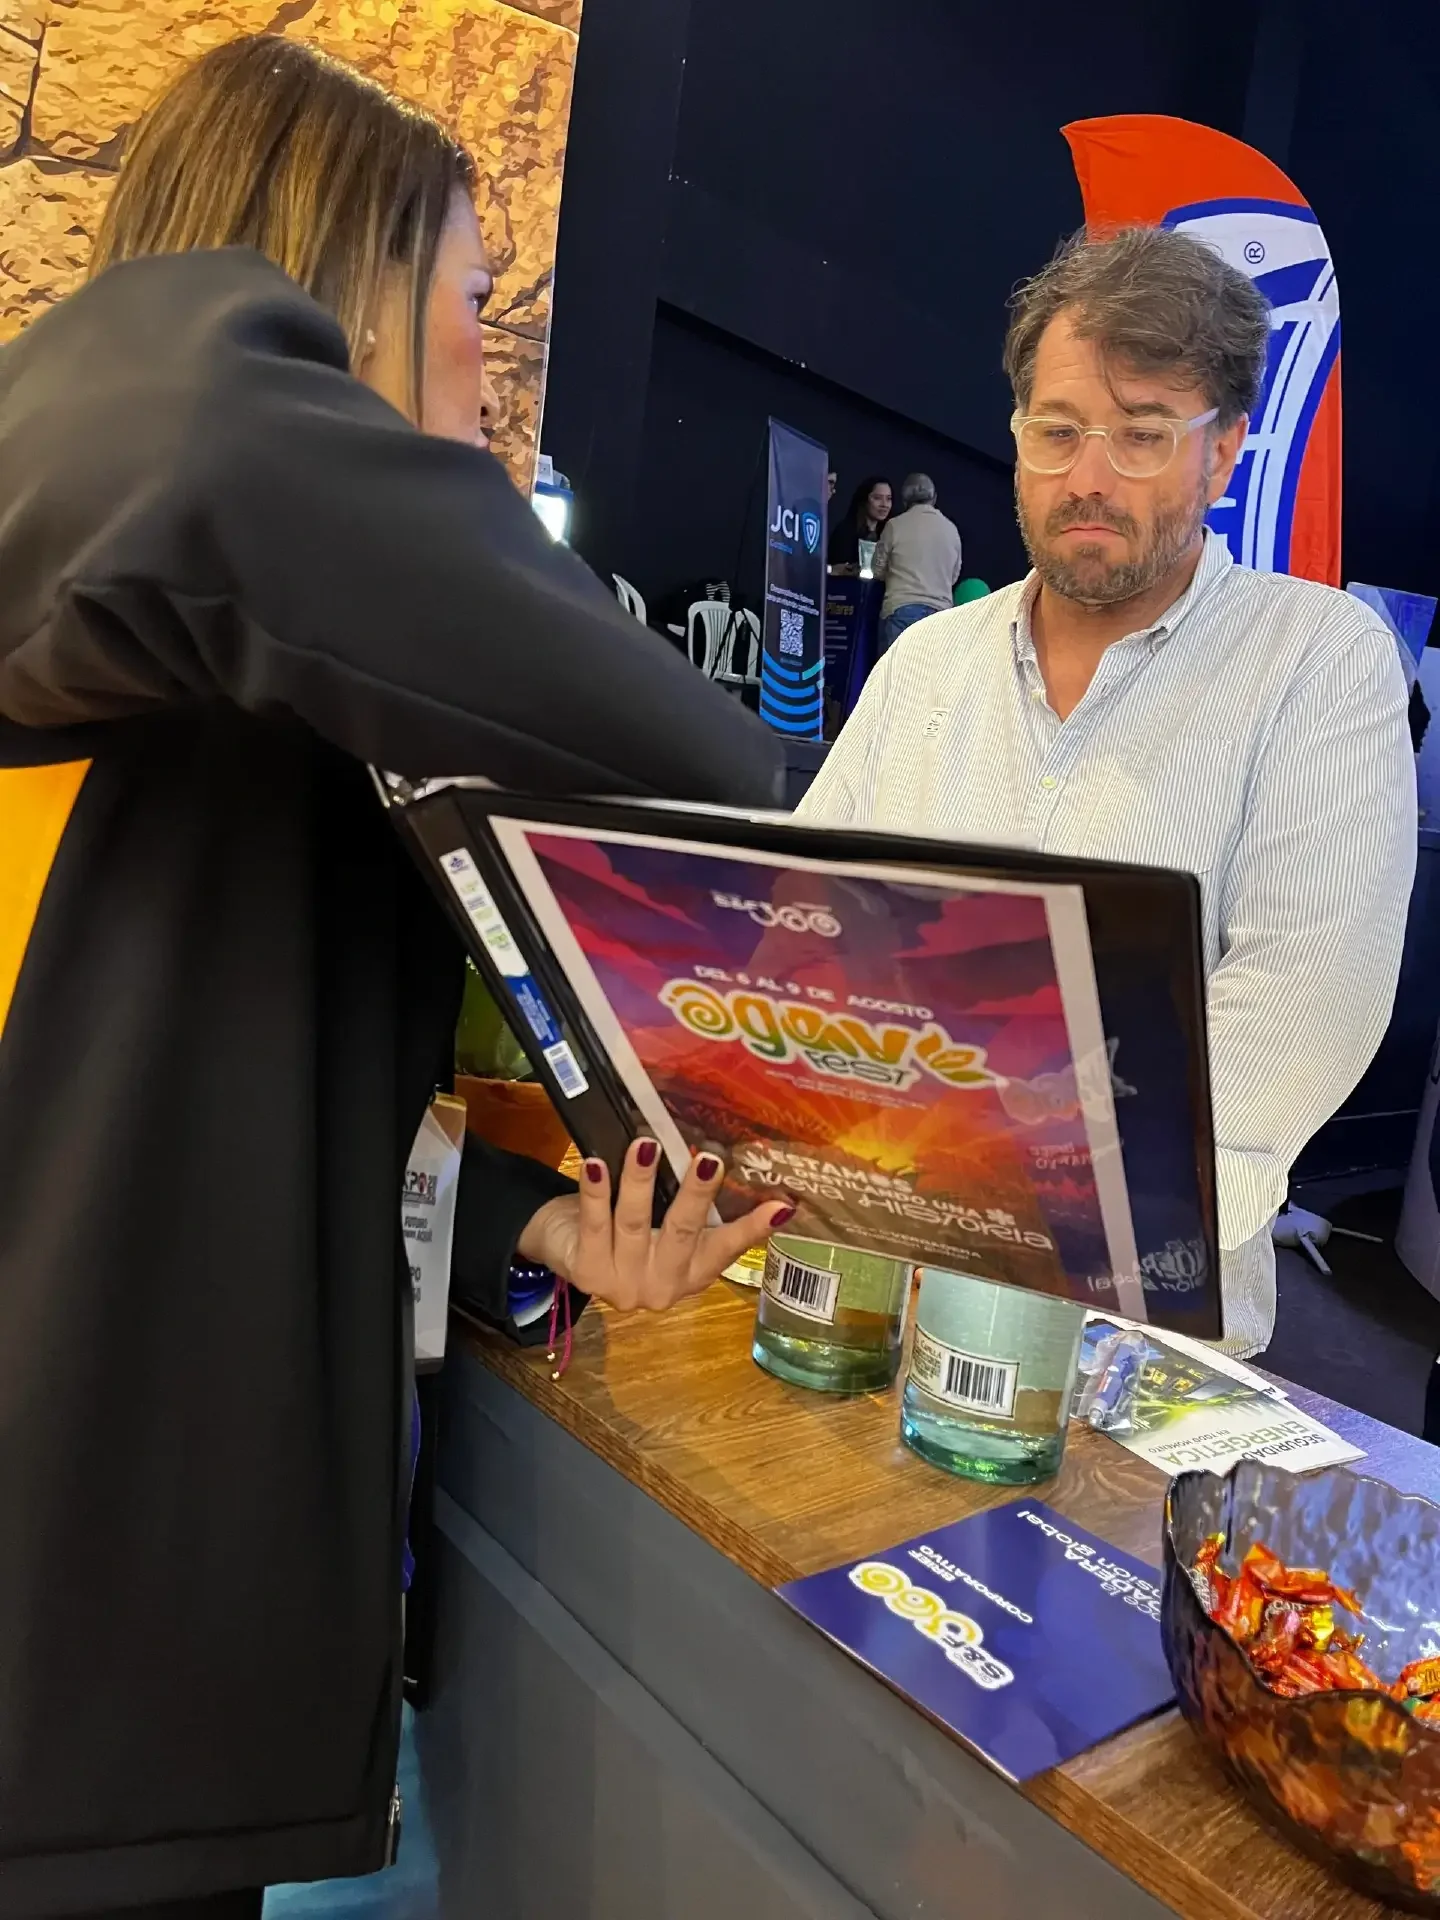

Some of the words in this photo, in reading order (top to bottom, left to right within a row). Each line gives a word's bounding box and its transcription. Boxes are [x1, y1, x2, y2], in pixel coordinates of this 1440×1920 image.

[770, 505, 800, 541] JCI
[847, 994, 935, 1020] AGOSTO
[933, 1200, 983, 1220] UNA
[1147, 1437, 1191, 1454] MOMENTO
[1157, 1420, 1311, 1467] ENERGETICA
[1240, 1433, 1326, 1460] SEGURIDAD
[1016, 1510, 1097, 1555] global
[908, 1548, 958, 1583] BRIEF
[919, 1544, 1034, 1625] CORPORATIVO
